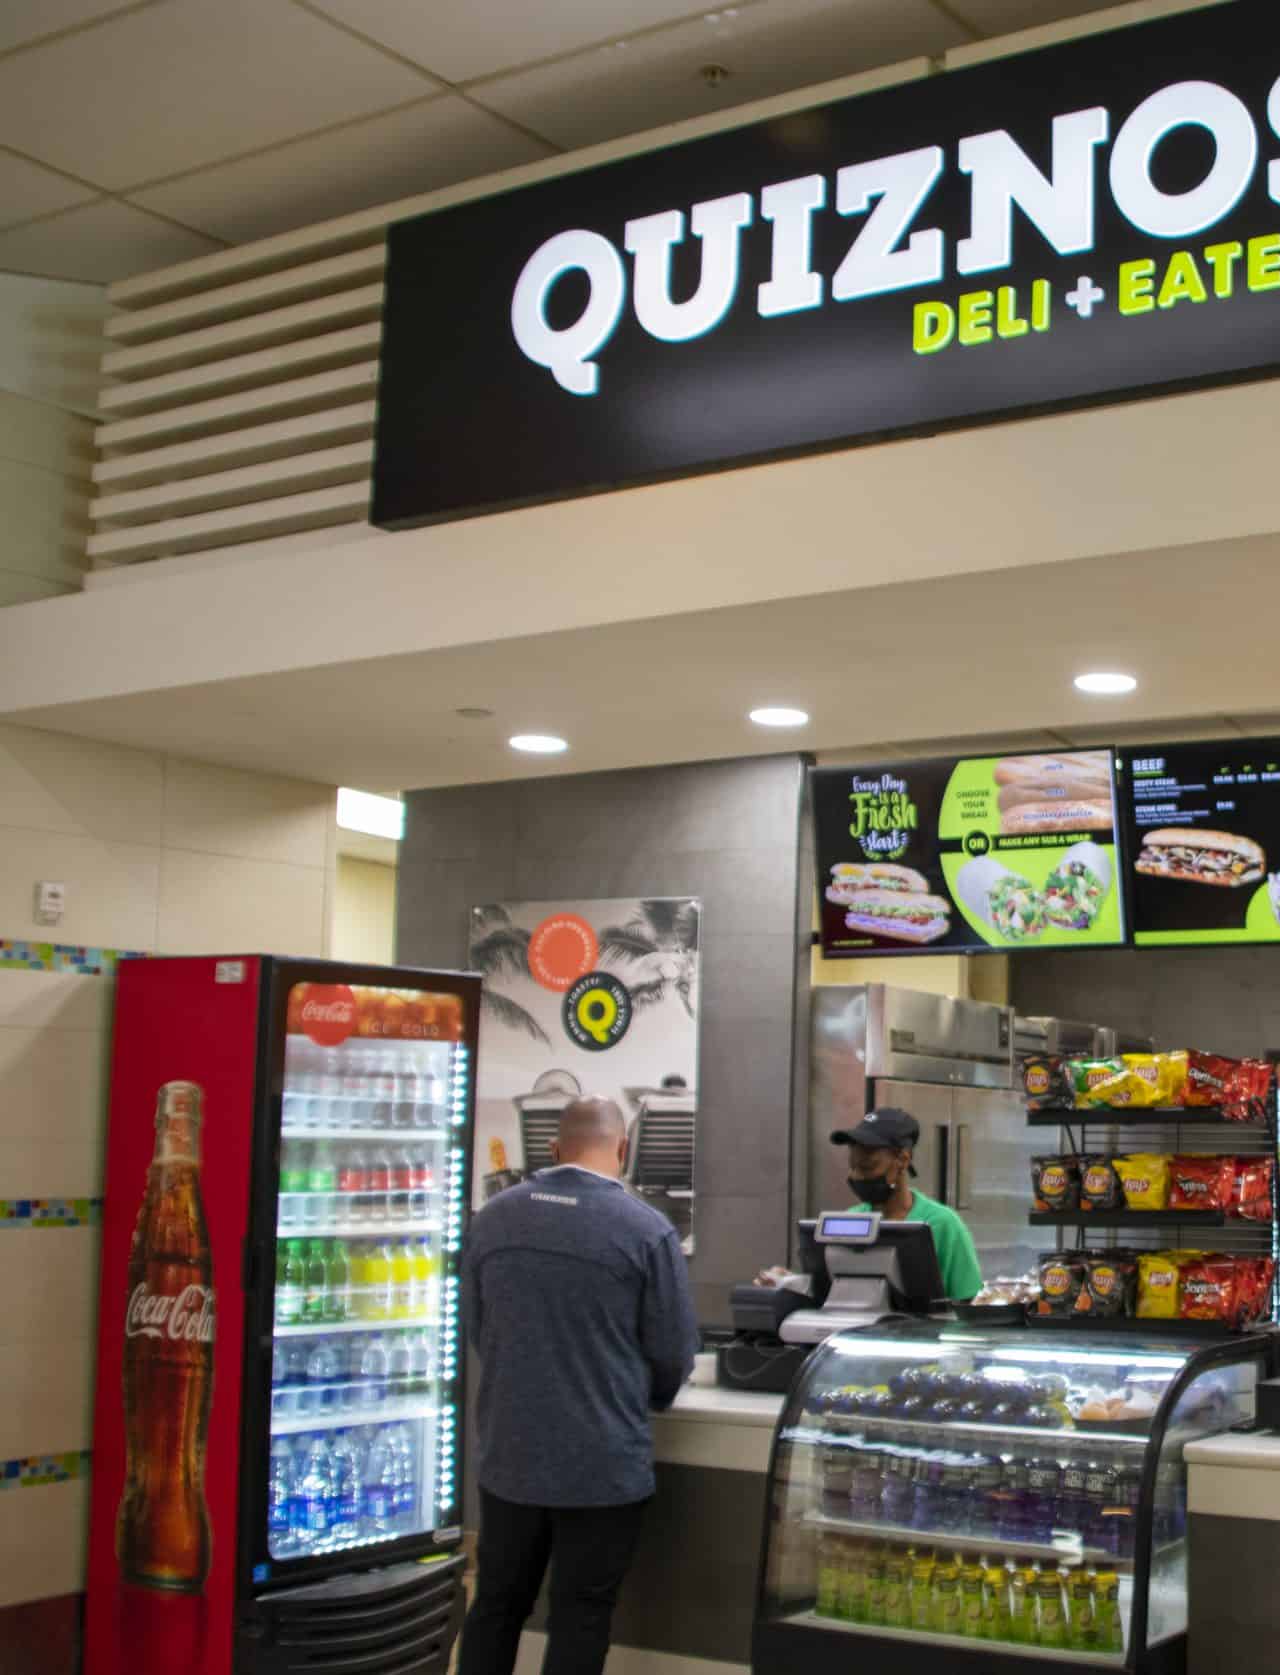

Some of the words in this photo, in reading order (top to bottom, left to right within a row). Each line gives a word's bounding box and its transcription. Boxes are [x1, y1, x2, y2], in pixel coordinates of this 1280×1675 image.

[912, 279, 1052, 354] DELI
[1132, 758, 1166, 771] BEEF
[849, 792, 918, 838] Fresh
[867, 829, 900, 850] start
[968, 839, 986, 849] OR
[126, 1282, 214, 1342] Coca-Cola
